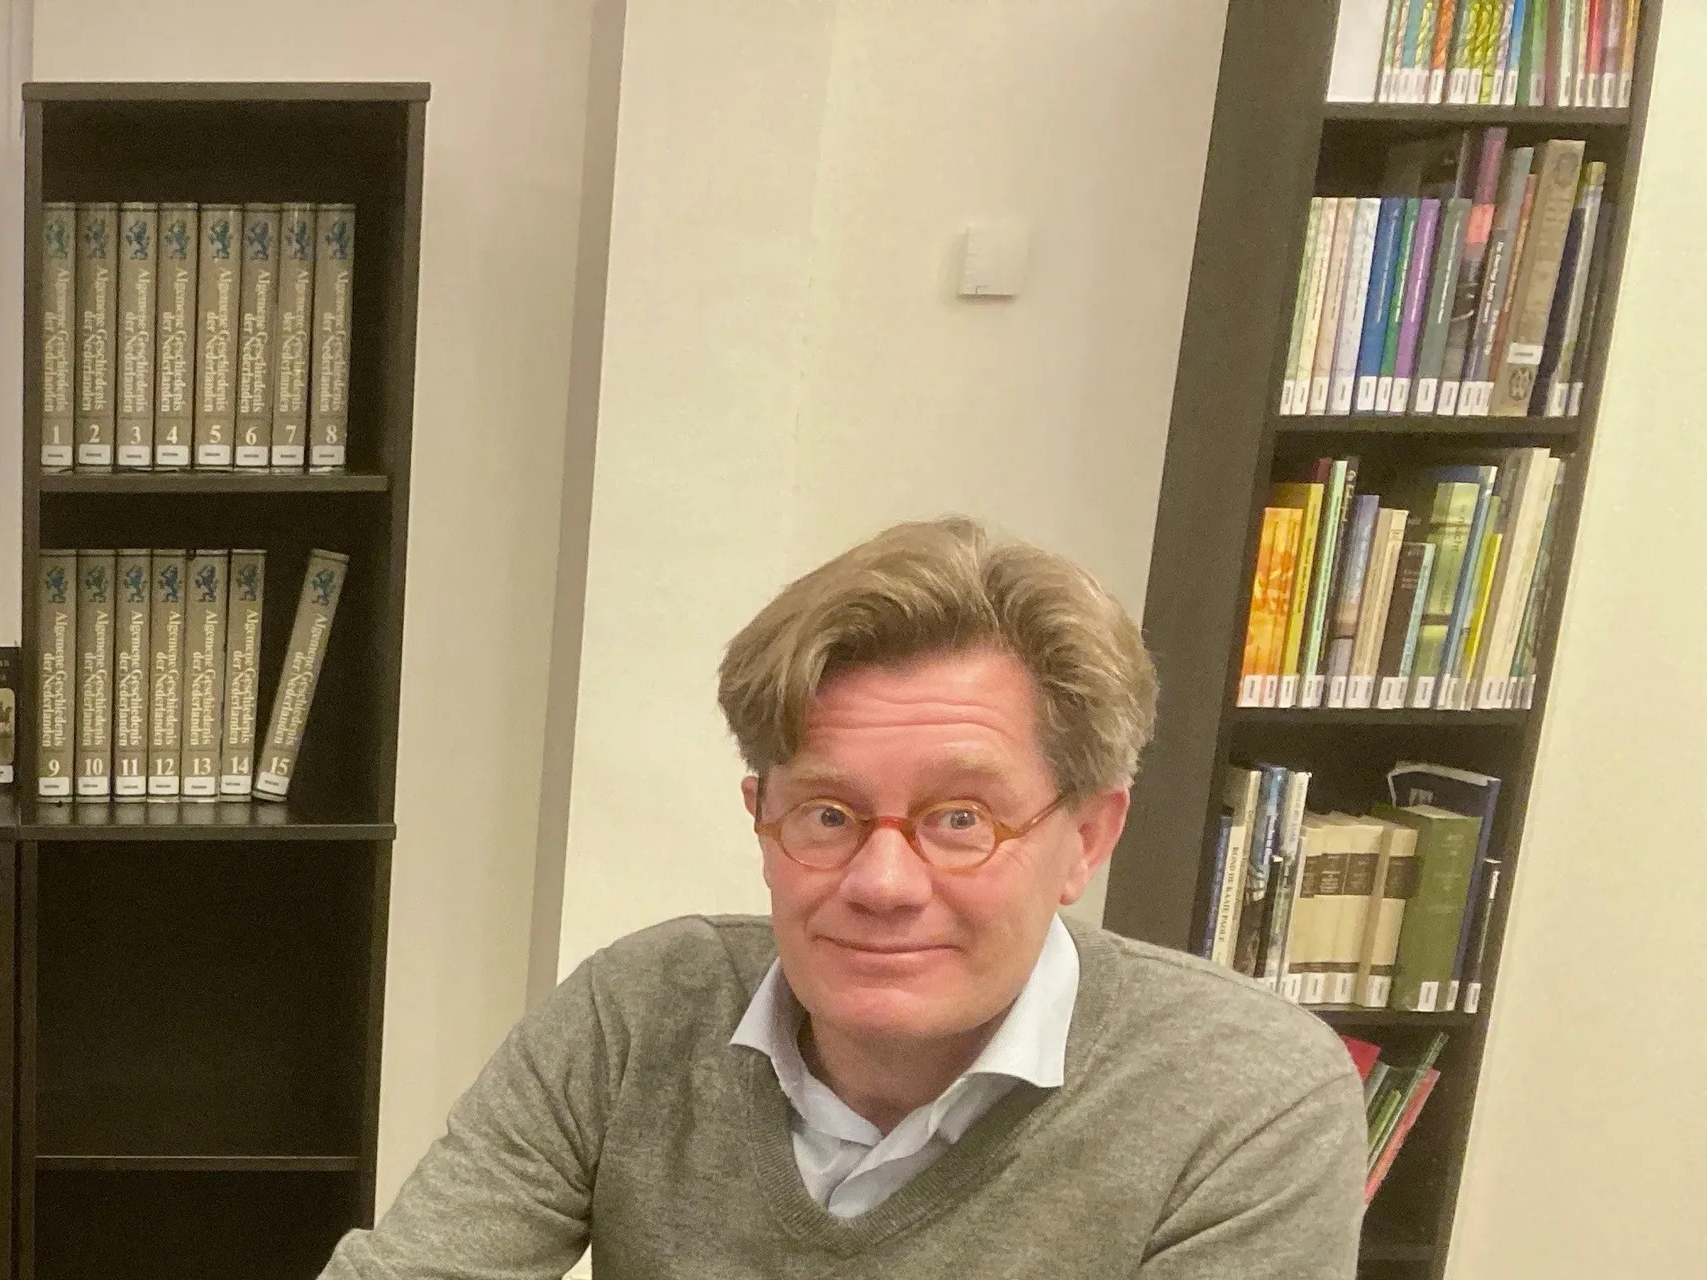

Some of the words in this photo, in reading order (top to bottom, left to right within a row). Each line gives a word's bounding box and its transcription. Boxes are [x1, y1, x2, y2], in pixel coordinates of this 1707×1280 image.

[53, 426, 59, 443] 1
[90, 424, 100, 442] 2
[131, 426, 141, 444] 3
[166, 426, 178, 443] 4
[210, 425, 221, 443] 5
[246, 426, 257, 445] 6
[286, 425, 296, 443] 7
[326, 425, 337, 443] 8
[44, 653, 55, 672] der
[85, 652, 96, 672] der
[120, 652, 131, 672] der
[156, 652, 167, 671] der
[193, 652, 204, 671] der
[233, 651, 245, 670] der
[293, 652, 305, 672] der
[42, 675, 55, 747] Nederlanden
[83, 673, 96, 746] Nederlanden
[119, 673, 131, 746] Nederlanden
[154, 673, 167, 745] Nederlanden
[191, 672, 204, 745] Nederlanden
[230, 672, 244, 744] Nederlanden
[274, 673, 303, 744] Nederlanden
[49, 760, 60, 776] 9
[85, 758, 103, 775] 10
[122, 759, 138, 775] 11
[156, 758, 174, 775] 12
[193, 758, 211, 775] 13
[231, 757, 249, 774] 14
[271, 757, 291, 775] 15
